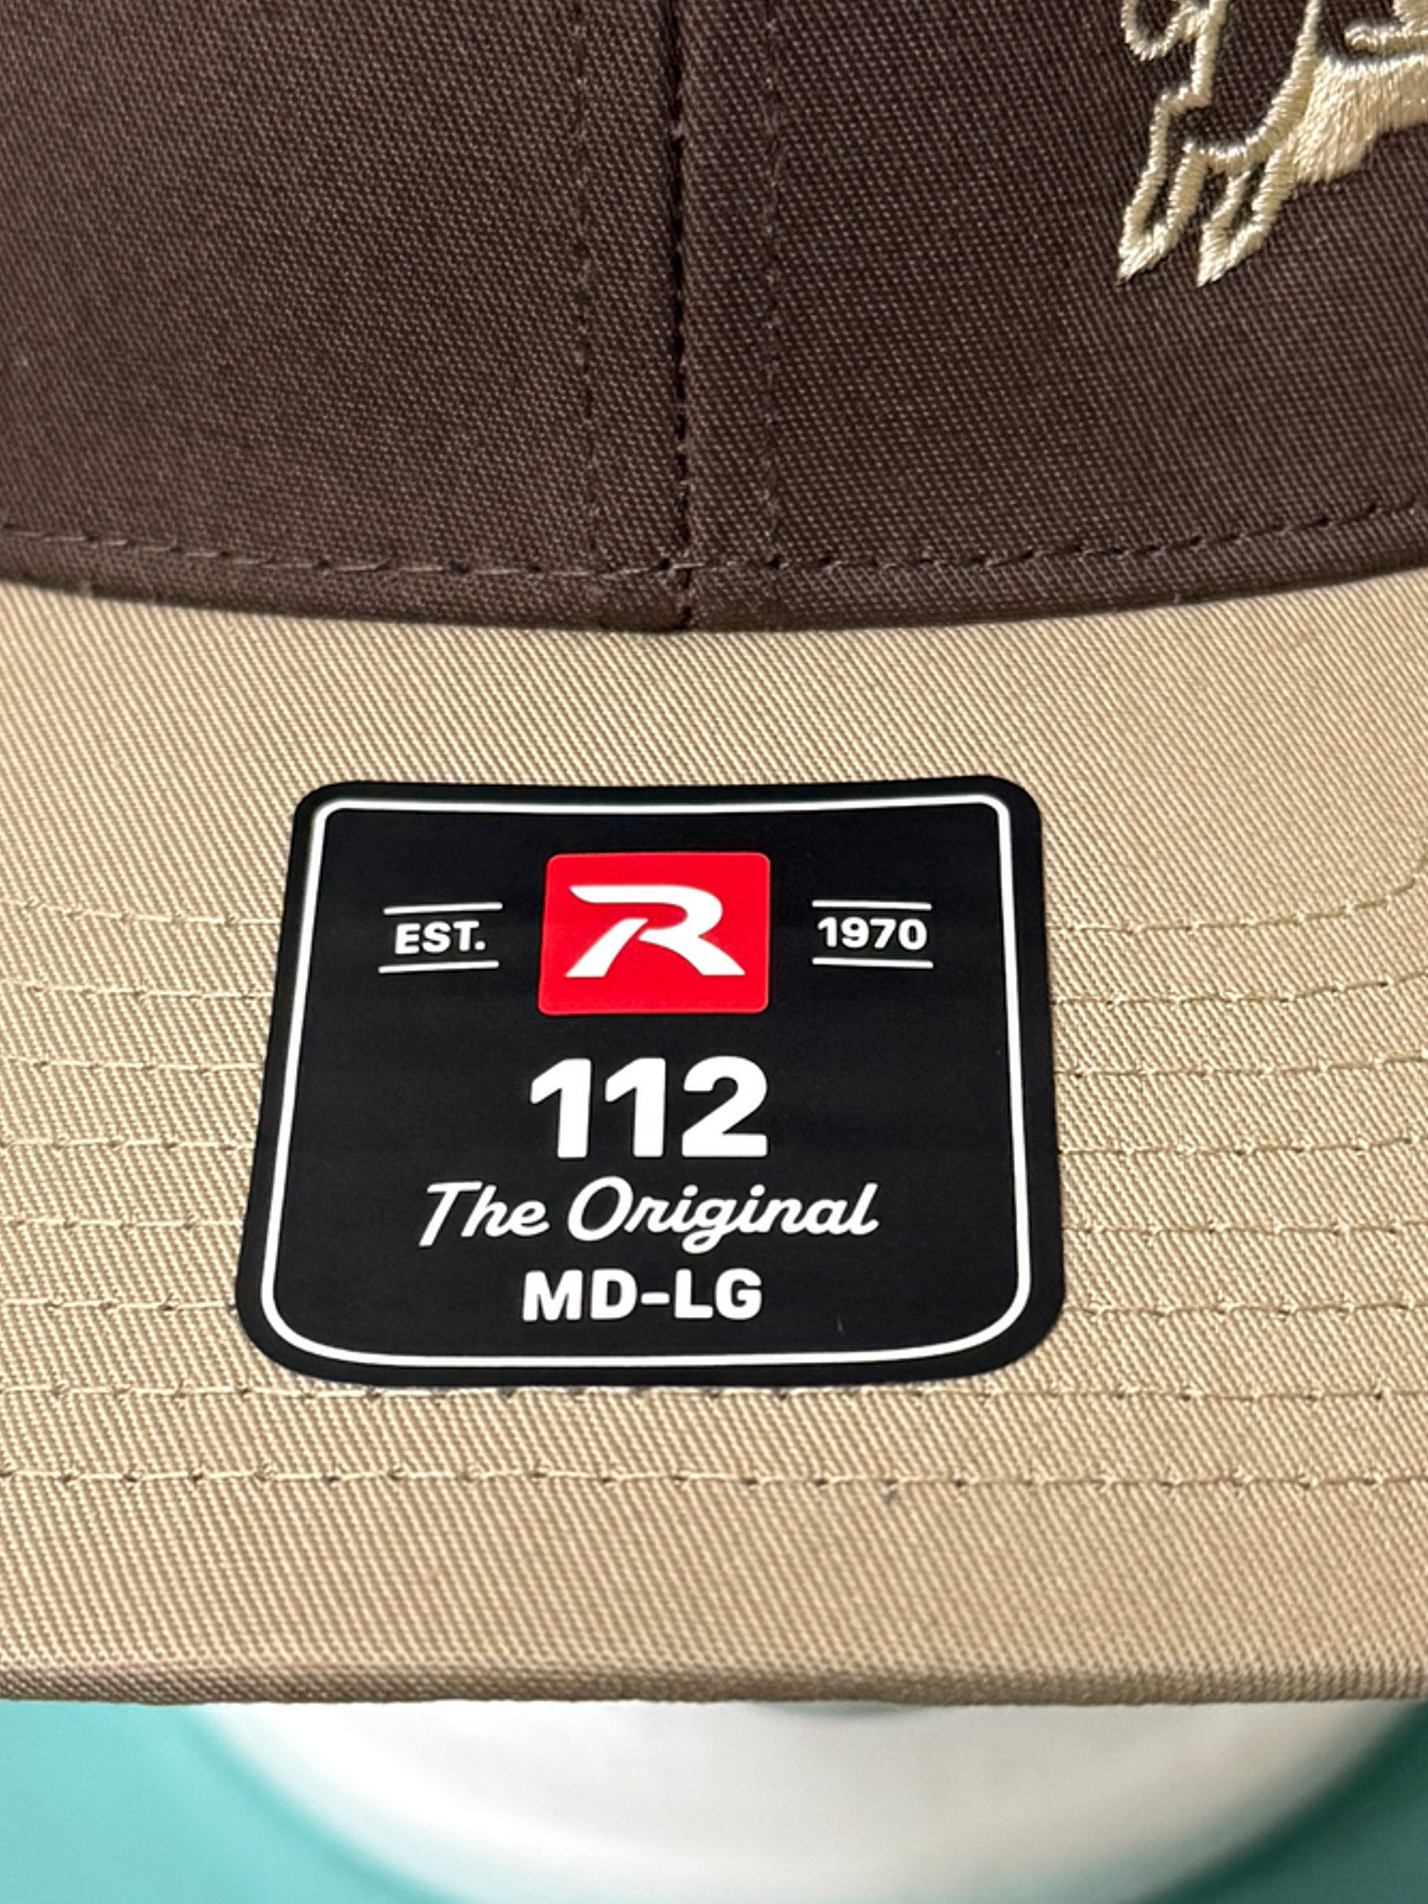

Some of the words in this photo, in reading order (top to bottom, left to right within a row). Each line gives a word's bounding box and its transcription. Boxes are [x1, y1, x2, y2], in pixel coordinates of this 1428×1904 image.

[394, 920, 486, 955] EST.
[565, 884, 747, 978] R
[817, 916, 928, 952] 1970
[530, 1055, 769, 1159] 112
[418, 1180, 550, 1247] The
[567, 1175, 880, 1255] Original
[522, 1268, 763, 1322] MD-LG
